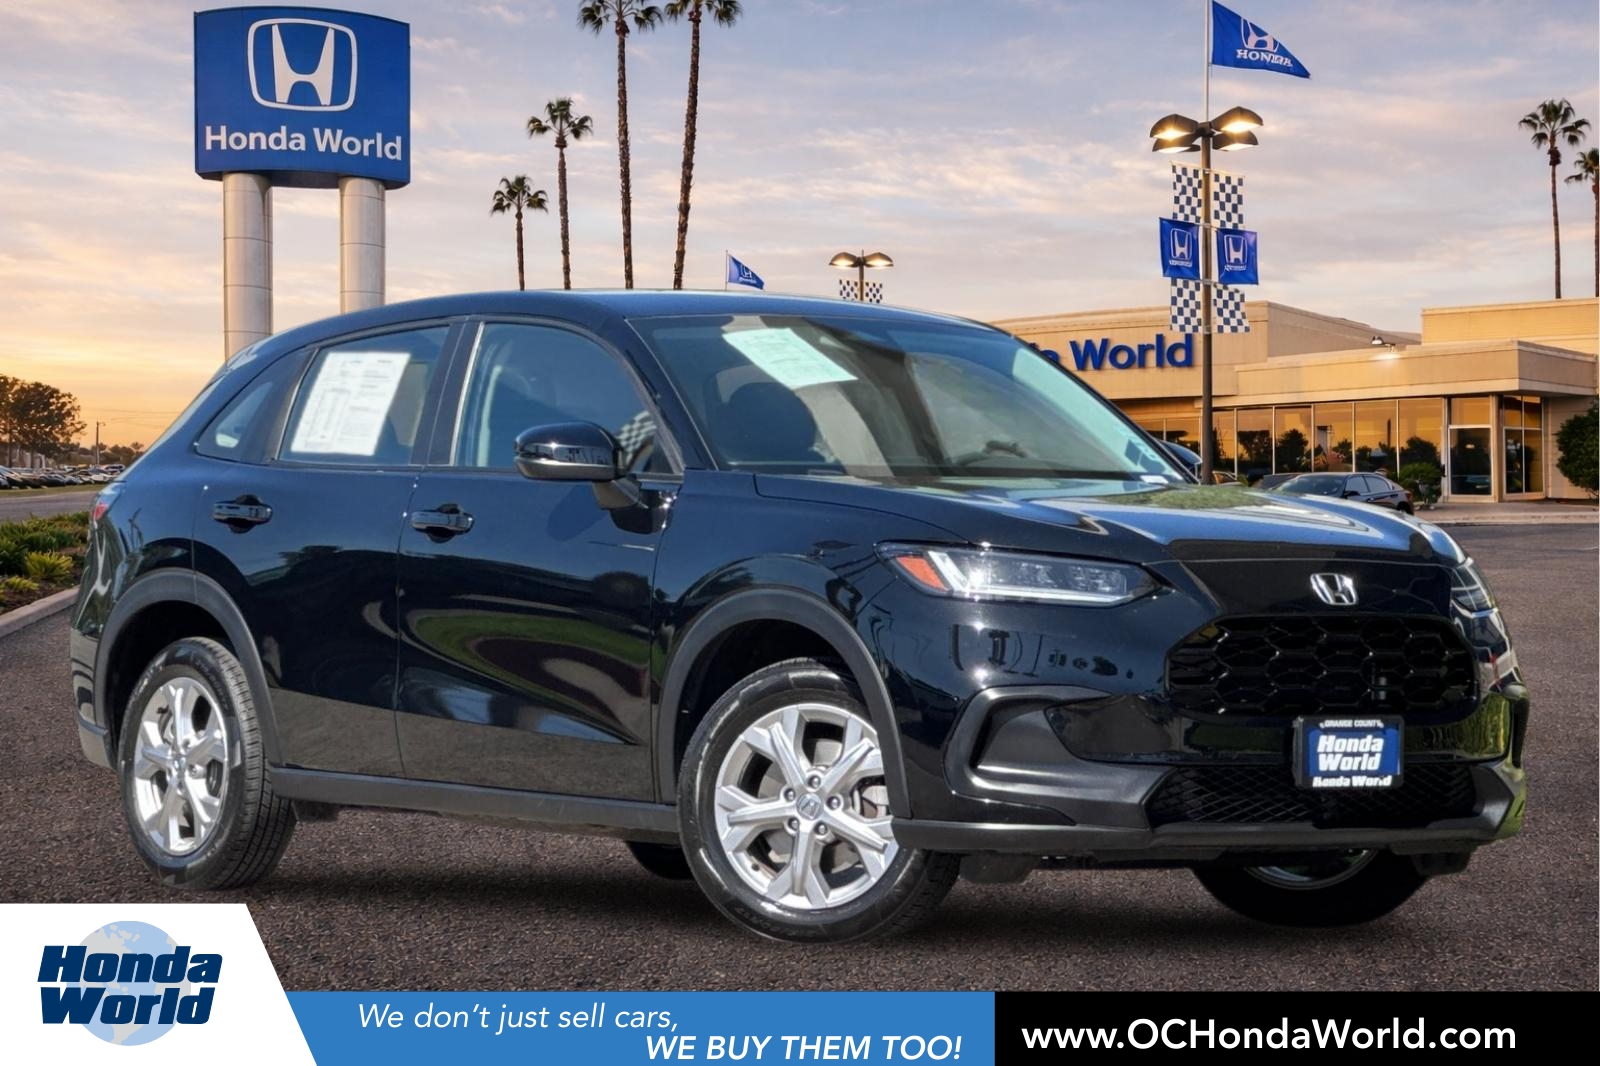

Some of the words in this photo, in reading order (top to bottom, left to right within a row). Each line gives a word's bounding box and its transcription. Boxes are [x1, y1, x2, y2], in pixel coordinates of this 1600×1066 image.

[205, 125, 306, 151] Honda
[313, 127, 402, 160] World
[1069, 333, 1193, 371] World
[1317, 734, 1384, 753] Honda
[1318, 752, 1381, 771] World
